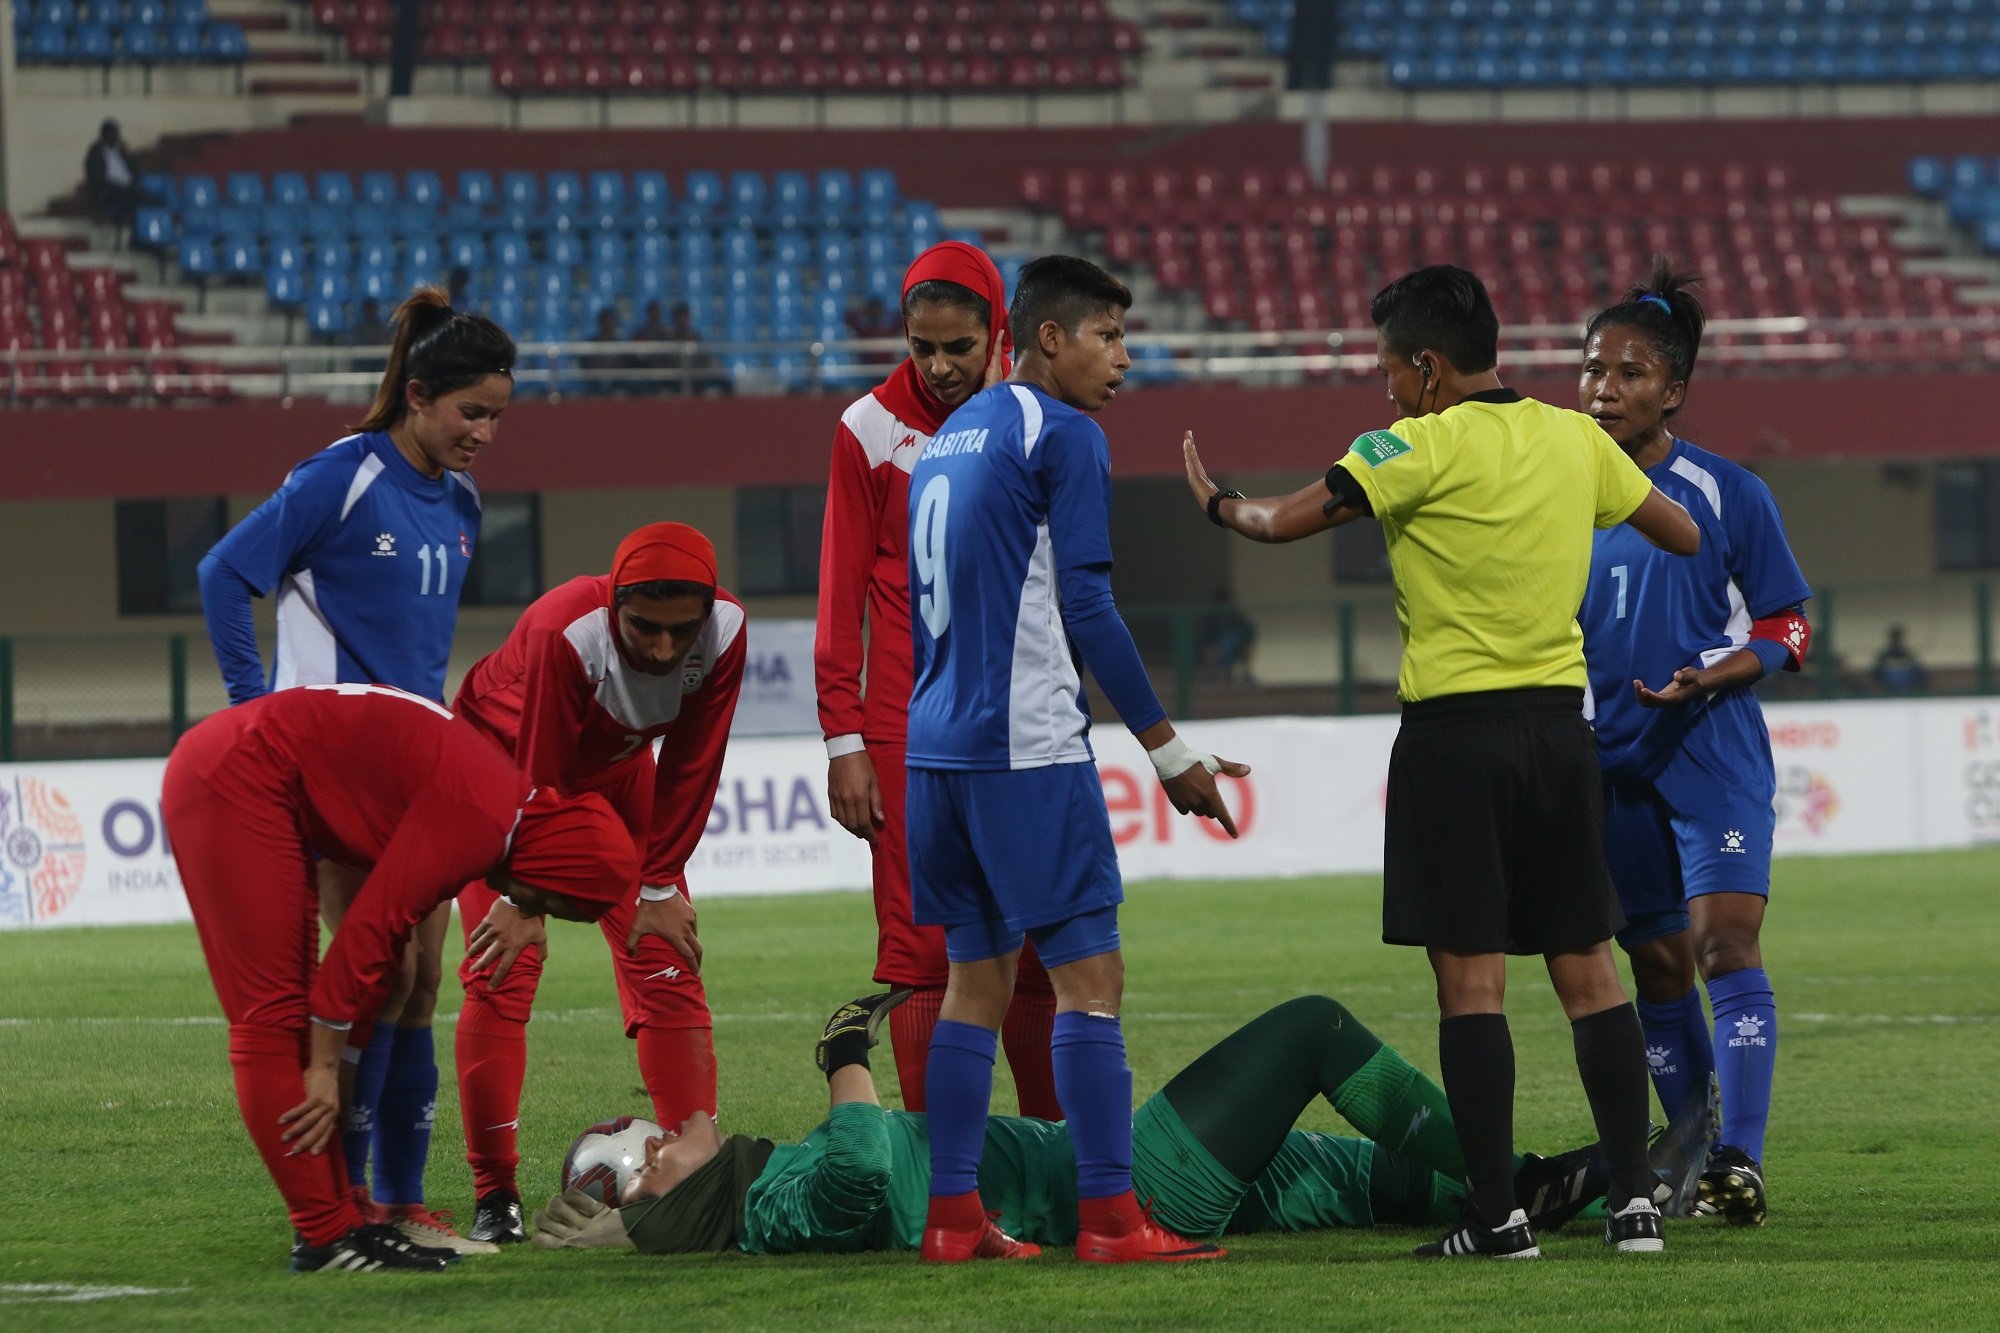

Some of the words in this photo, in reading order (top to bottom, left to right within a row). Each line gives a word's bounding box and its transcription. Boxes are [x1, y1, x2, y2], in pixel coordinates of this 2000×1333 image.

[921, 428, 990, 461] SABITRA
[1372, 447, 1385, 460] FIFA
[417, 543, 448, 596] 11
[914, 474, 950, 640] 9
[1611, 564, 1628, 619] 1
[1783, 636, 1801, 656] KELME
[609, 734, 643, 762] 2
[1728, 1036, 1767, 1048] KELME
[1648, 1064, 1677, 1076] ELME
